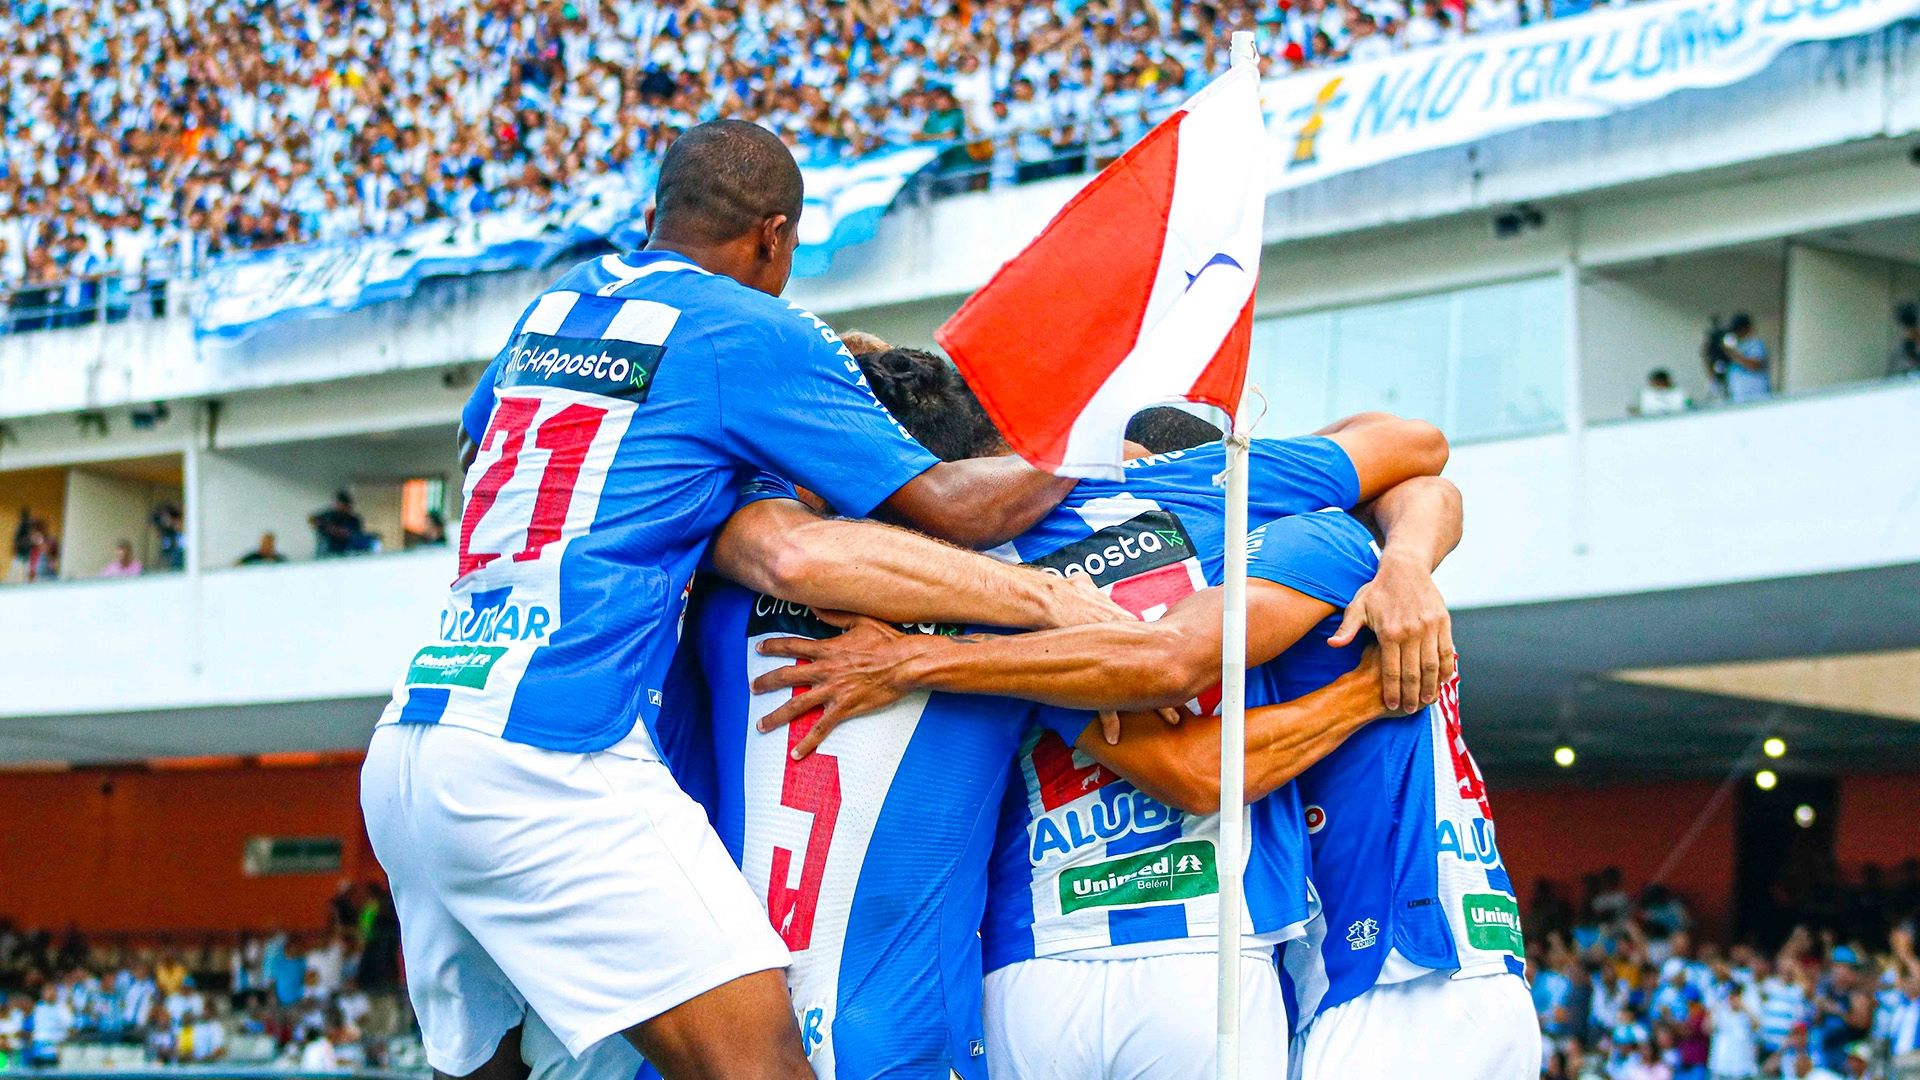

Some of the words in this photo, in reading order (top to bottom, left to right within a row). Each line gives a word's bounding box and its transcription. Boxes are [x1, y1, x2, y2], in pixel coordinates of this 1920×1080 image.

[450, 397, 609, 588] 21
[1031, 790, 1184, 862] ALUB
[1073, 857, 1169, 895] Unimed
[1137, 878, 1169, 890] Belém
